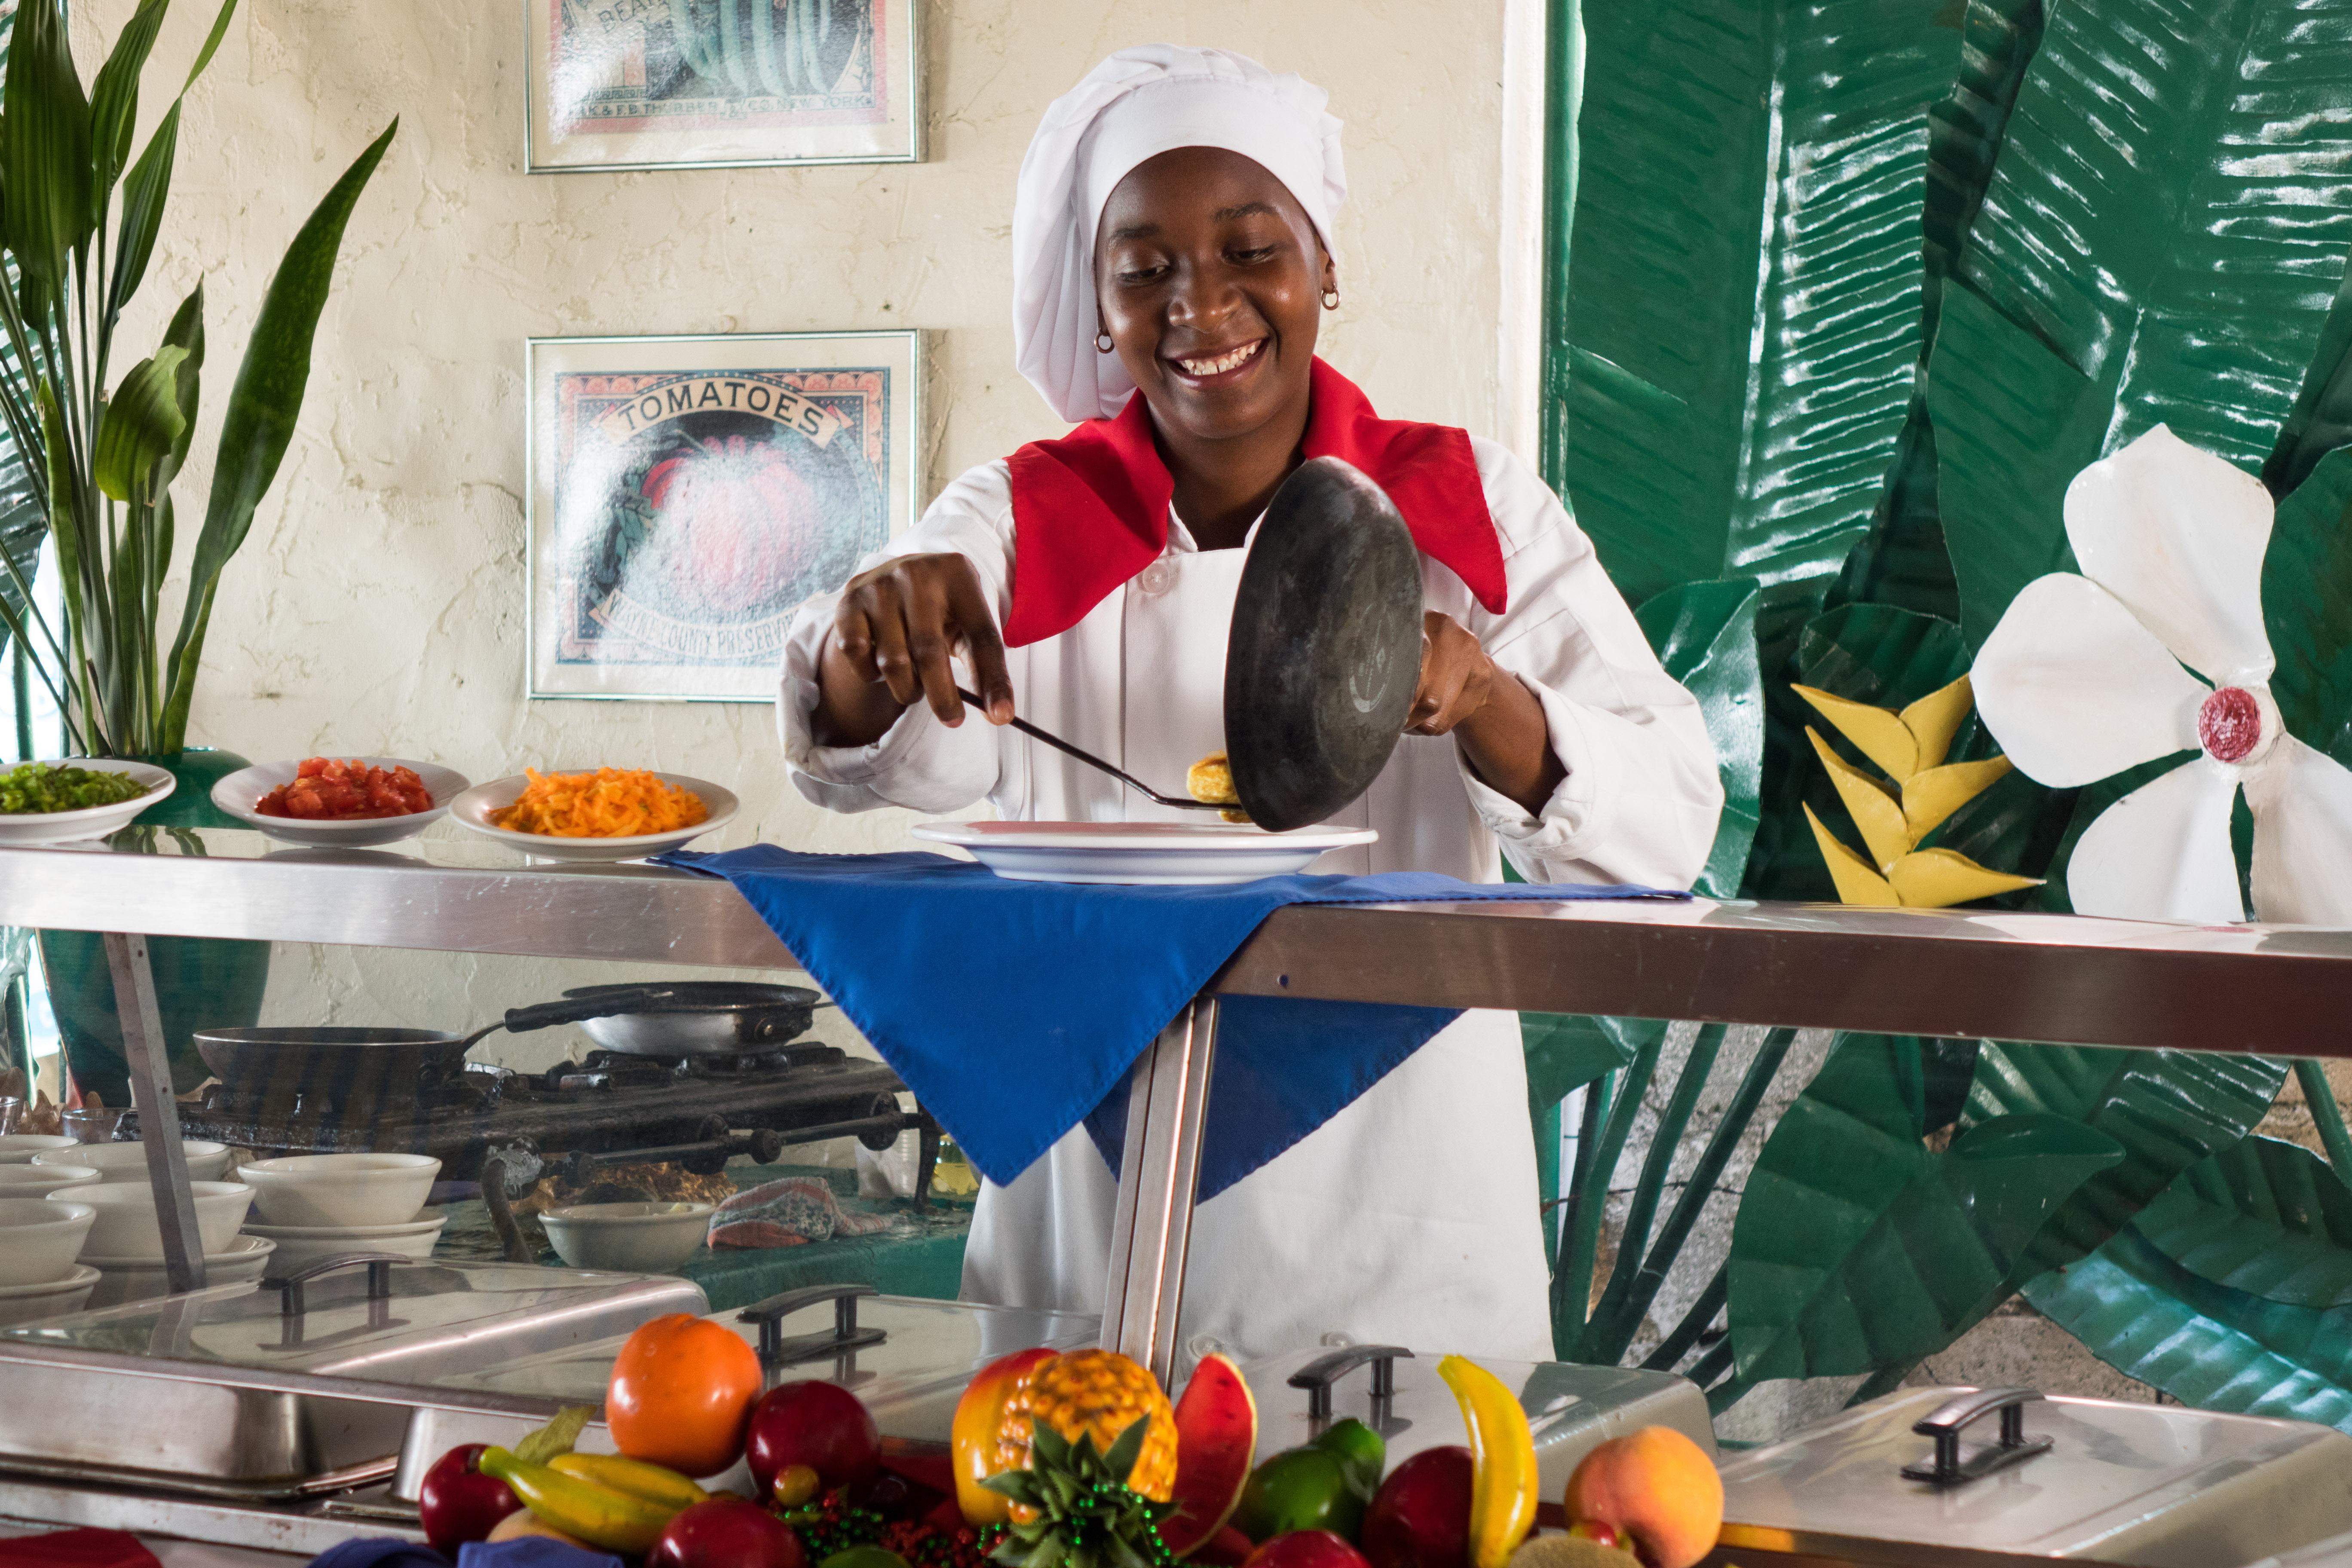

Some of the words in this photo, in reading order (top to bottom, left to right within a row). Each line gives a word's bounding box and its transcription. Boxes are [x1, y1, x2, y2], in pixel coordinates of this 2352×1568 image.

[597, 0, 653, 33] BEA
[777, 98, 811, 110] NEW
[618, 381, 825, 437] TOMATOES
[661, 622, 712, 654] COUNTY
